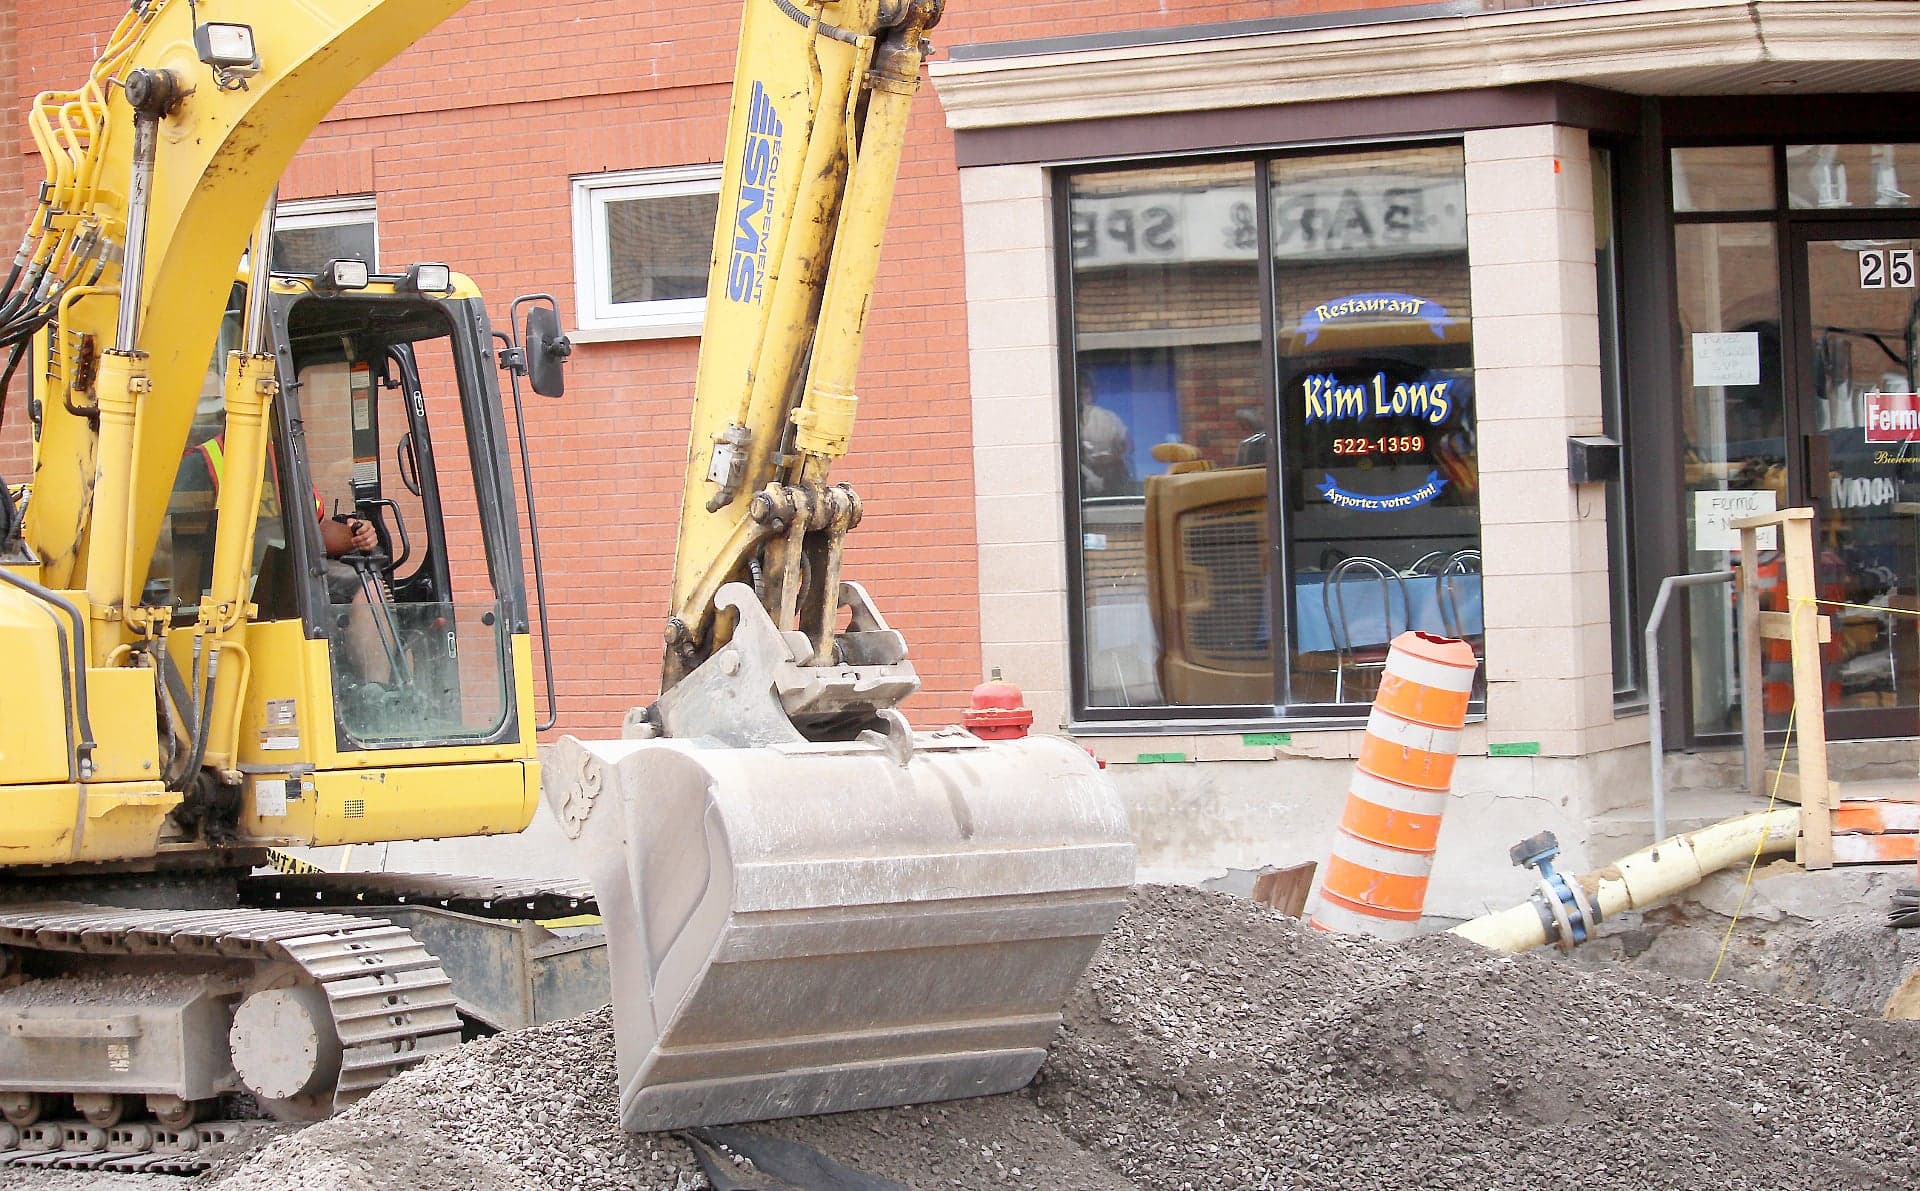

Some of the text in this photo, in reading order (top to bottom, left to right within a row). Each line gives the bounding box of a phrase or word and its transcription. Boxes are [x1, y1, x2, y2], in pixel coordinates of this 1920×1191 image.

[729, 135, 770, 303] SMS
[1862, 252, 1912, 286] 25
[1302, 372, 1450, 424] Kim Long
[1868, 403, 1920, 431] Ferm
[1333, 436, 1422, 454] 522-1359
[1324, 483, 1437, 509] Apportez votre vin!
